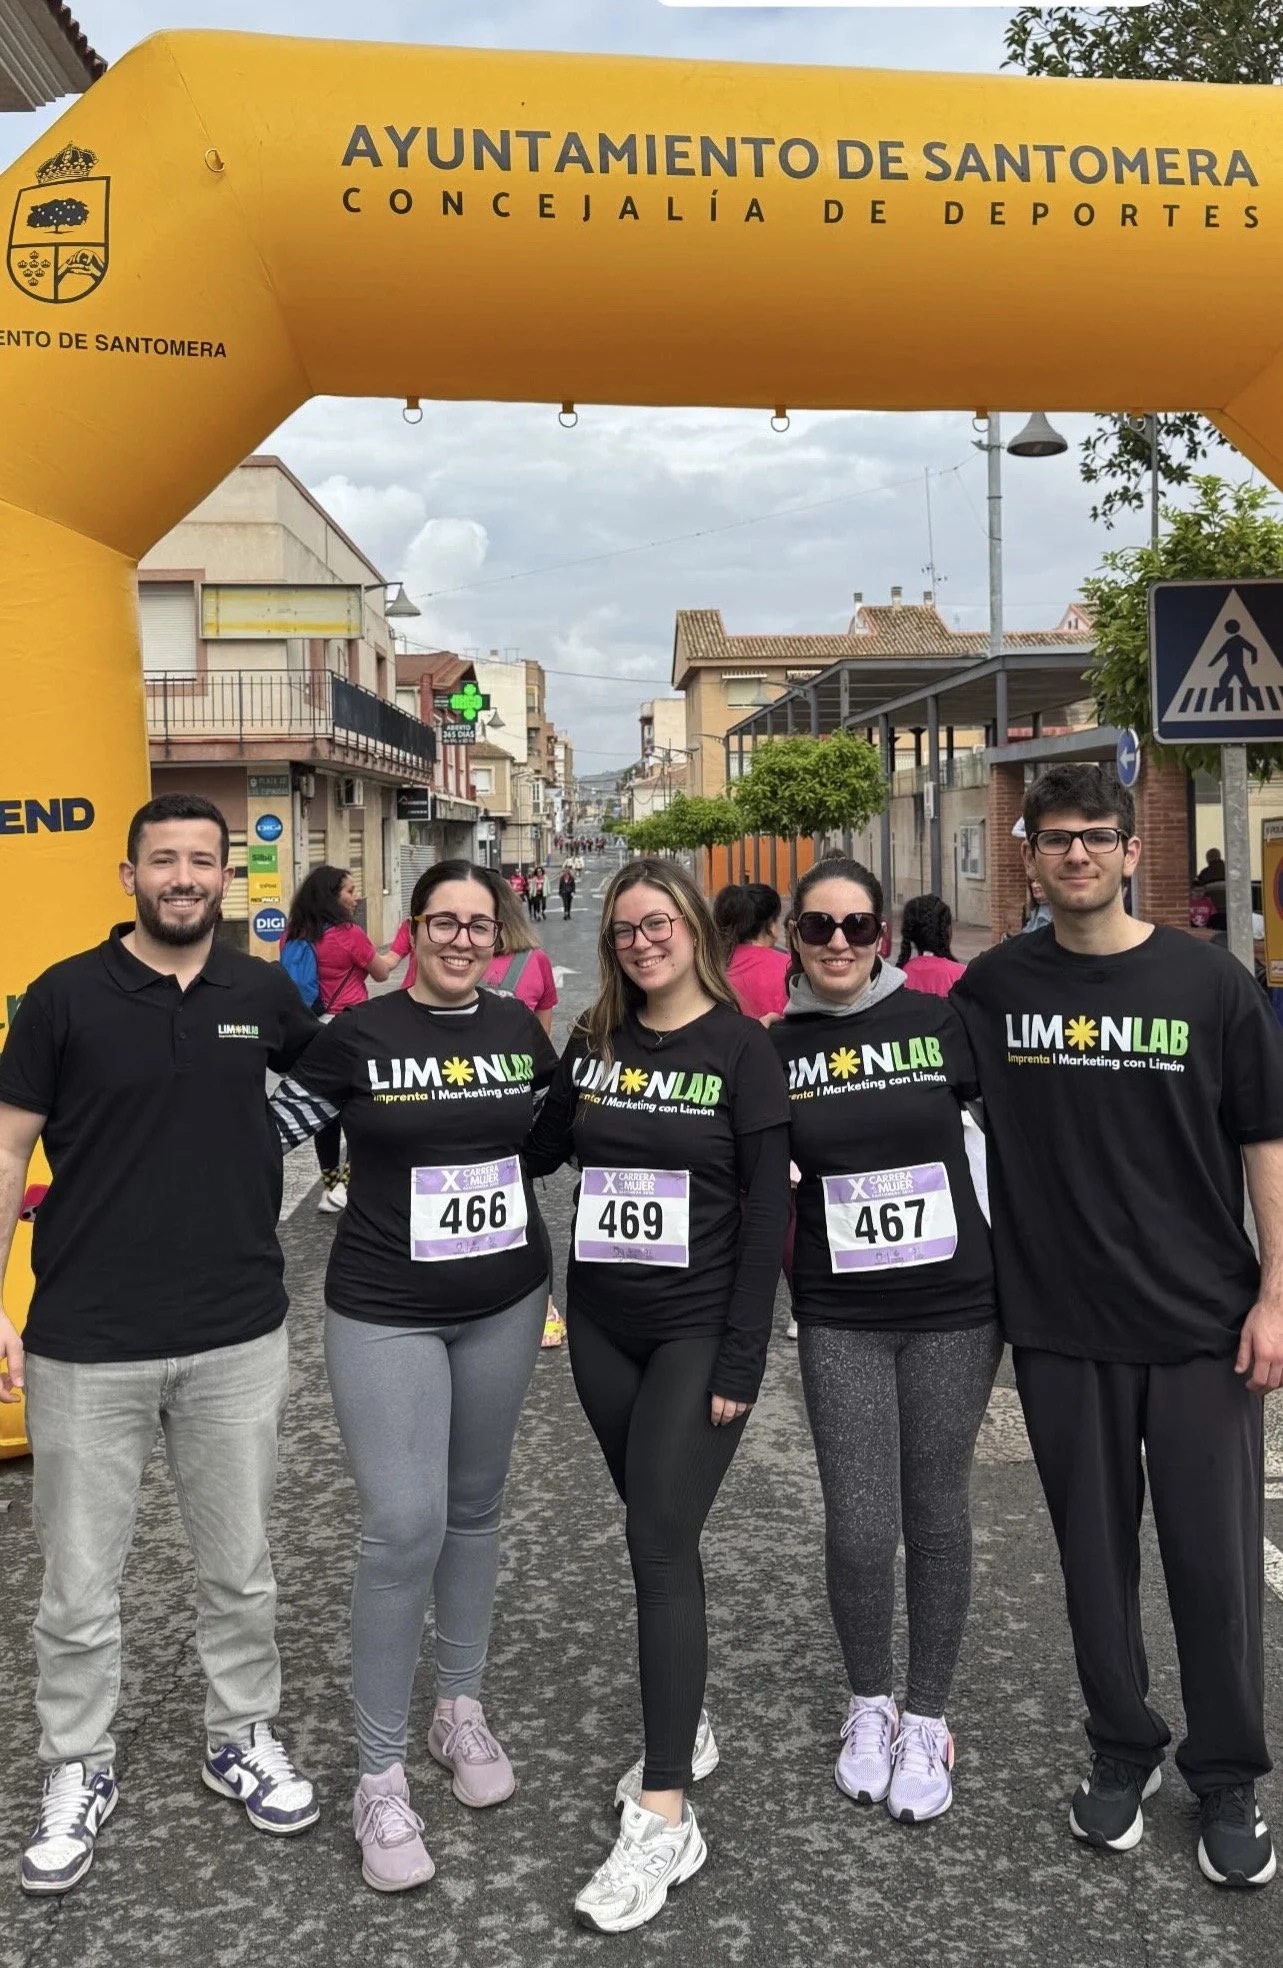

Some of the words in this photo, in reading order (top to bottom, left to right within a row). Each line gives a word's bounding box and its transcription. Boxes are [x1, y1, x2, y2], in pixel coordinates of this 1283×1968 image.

[341, 123, 820, 181] AYUNTAMIENTO
[837, 139, 910, 181] DE
[923, 140, 1260, 188] SANTOMERA
[342, 186, 766, 223] CONCEJALÍA
[823, 199, 887, 224] DE
[943, 201, 1259, 229] DEPORTES
[59, 332, 88, 349] DE
[95, 334, 227, 358] SANTOMERA
[443, 730, 456, 738] 365
[0, 797, 95, 835] END
[256, 917, 285, 929] DIGI
[788, 1036, 944, 1090] IMNLAB
[1007, 1052, 1051, 1065] Imprenta
[1058, 1053, 1120, 1070] Marketing
[1123, 1059, 1146, 1069] con
[1149, 1058, 1185, 1072] Limón
[438, 1087, 503, 1100] Marketing
[504, 1087, 521, 1096] con
[822, 1078, 886, 1096] Marketing
[889, 1076, 911, 1085] con
[912, 1071, 947, 1083] Limón
[607, 1096, 657, 1112] Marketing
[658, 1104, 678, 1113] con
[680, 1103, 715, 1117] Limón
[440, 1170, 461, 1192] X
[462, 1165, 500, 1178] CARRERA
[470, 1173, 500, 1186] MUJER
[601, 1171, 618, 1194] X
[618, 1172, 656, 1182] CARRERA
[623, 1181, 655, 1191] MUJER
[847, 1177, 871, 1200] X
[869, 1171, 913, 1185] CARRERA
[877, 1179, 914, 1193] MUJER
[439, 1191, 507, 1234] 466
[598, 1200, 663, 1241] 469
[854, 1198, 926, 1244] 467
